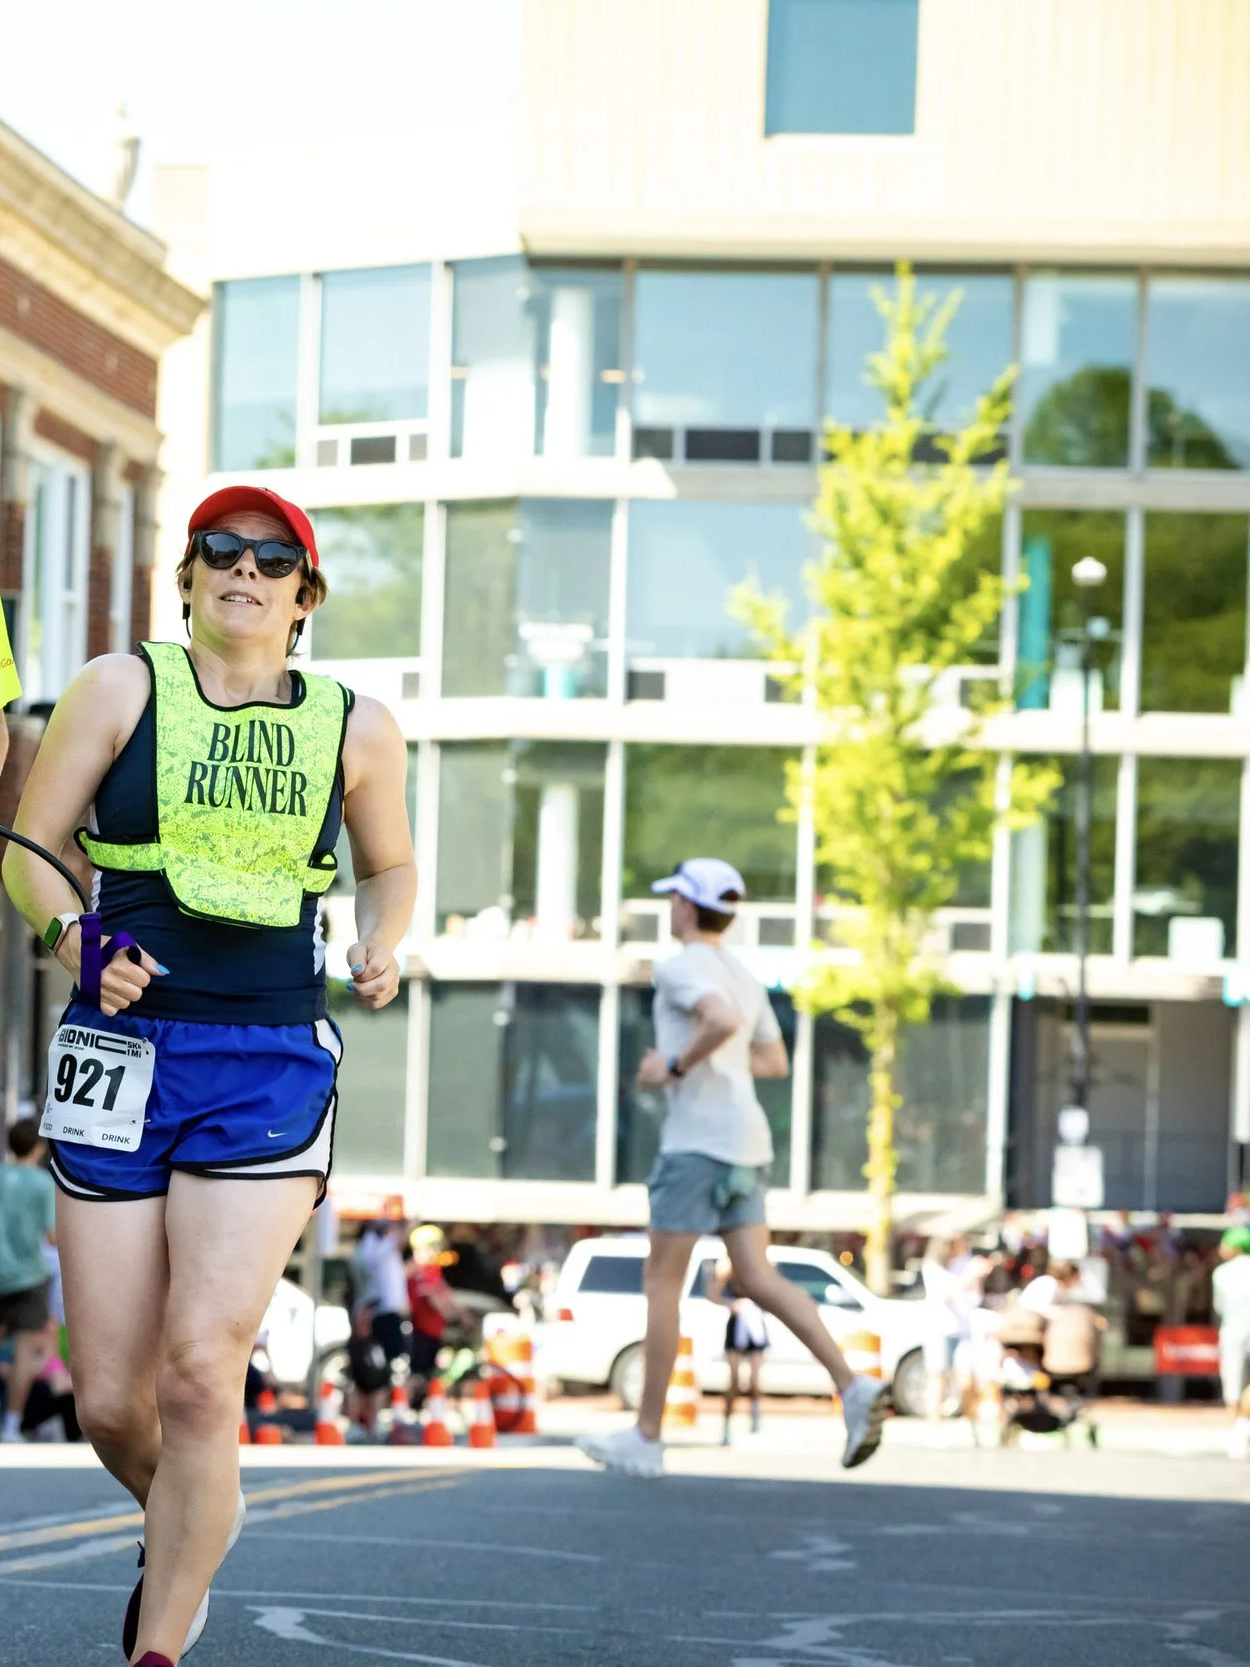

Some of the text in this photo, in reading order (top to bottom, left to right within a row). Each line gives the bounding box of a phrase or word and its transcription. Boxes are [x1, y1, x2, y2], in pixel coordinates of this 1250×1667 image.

[207, 719, 295, 767] BLIND
[183, 760, 307, 817] RUNNER
[58, 1028, 127, 1055] BIONIC
[54, 1053, 126, 1112] 921
[62, 1126, 85, 1137] DRINK
[101, 1133, 131, 1144] DRINK
